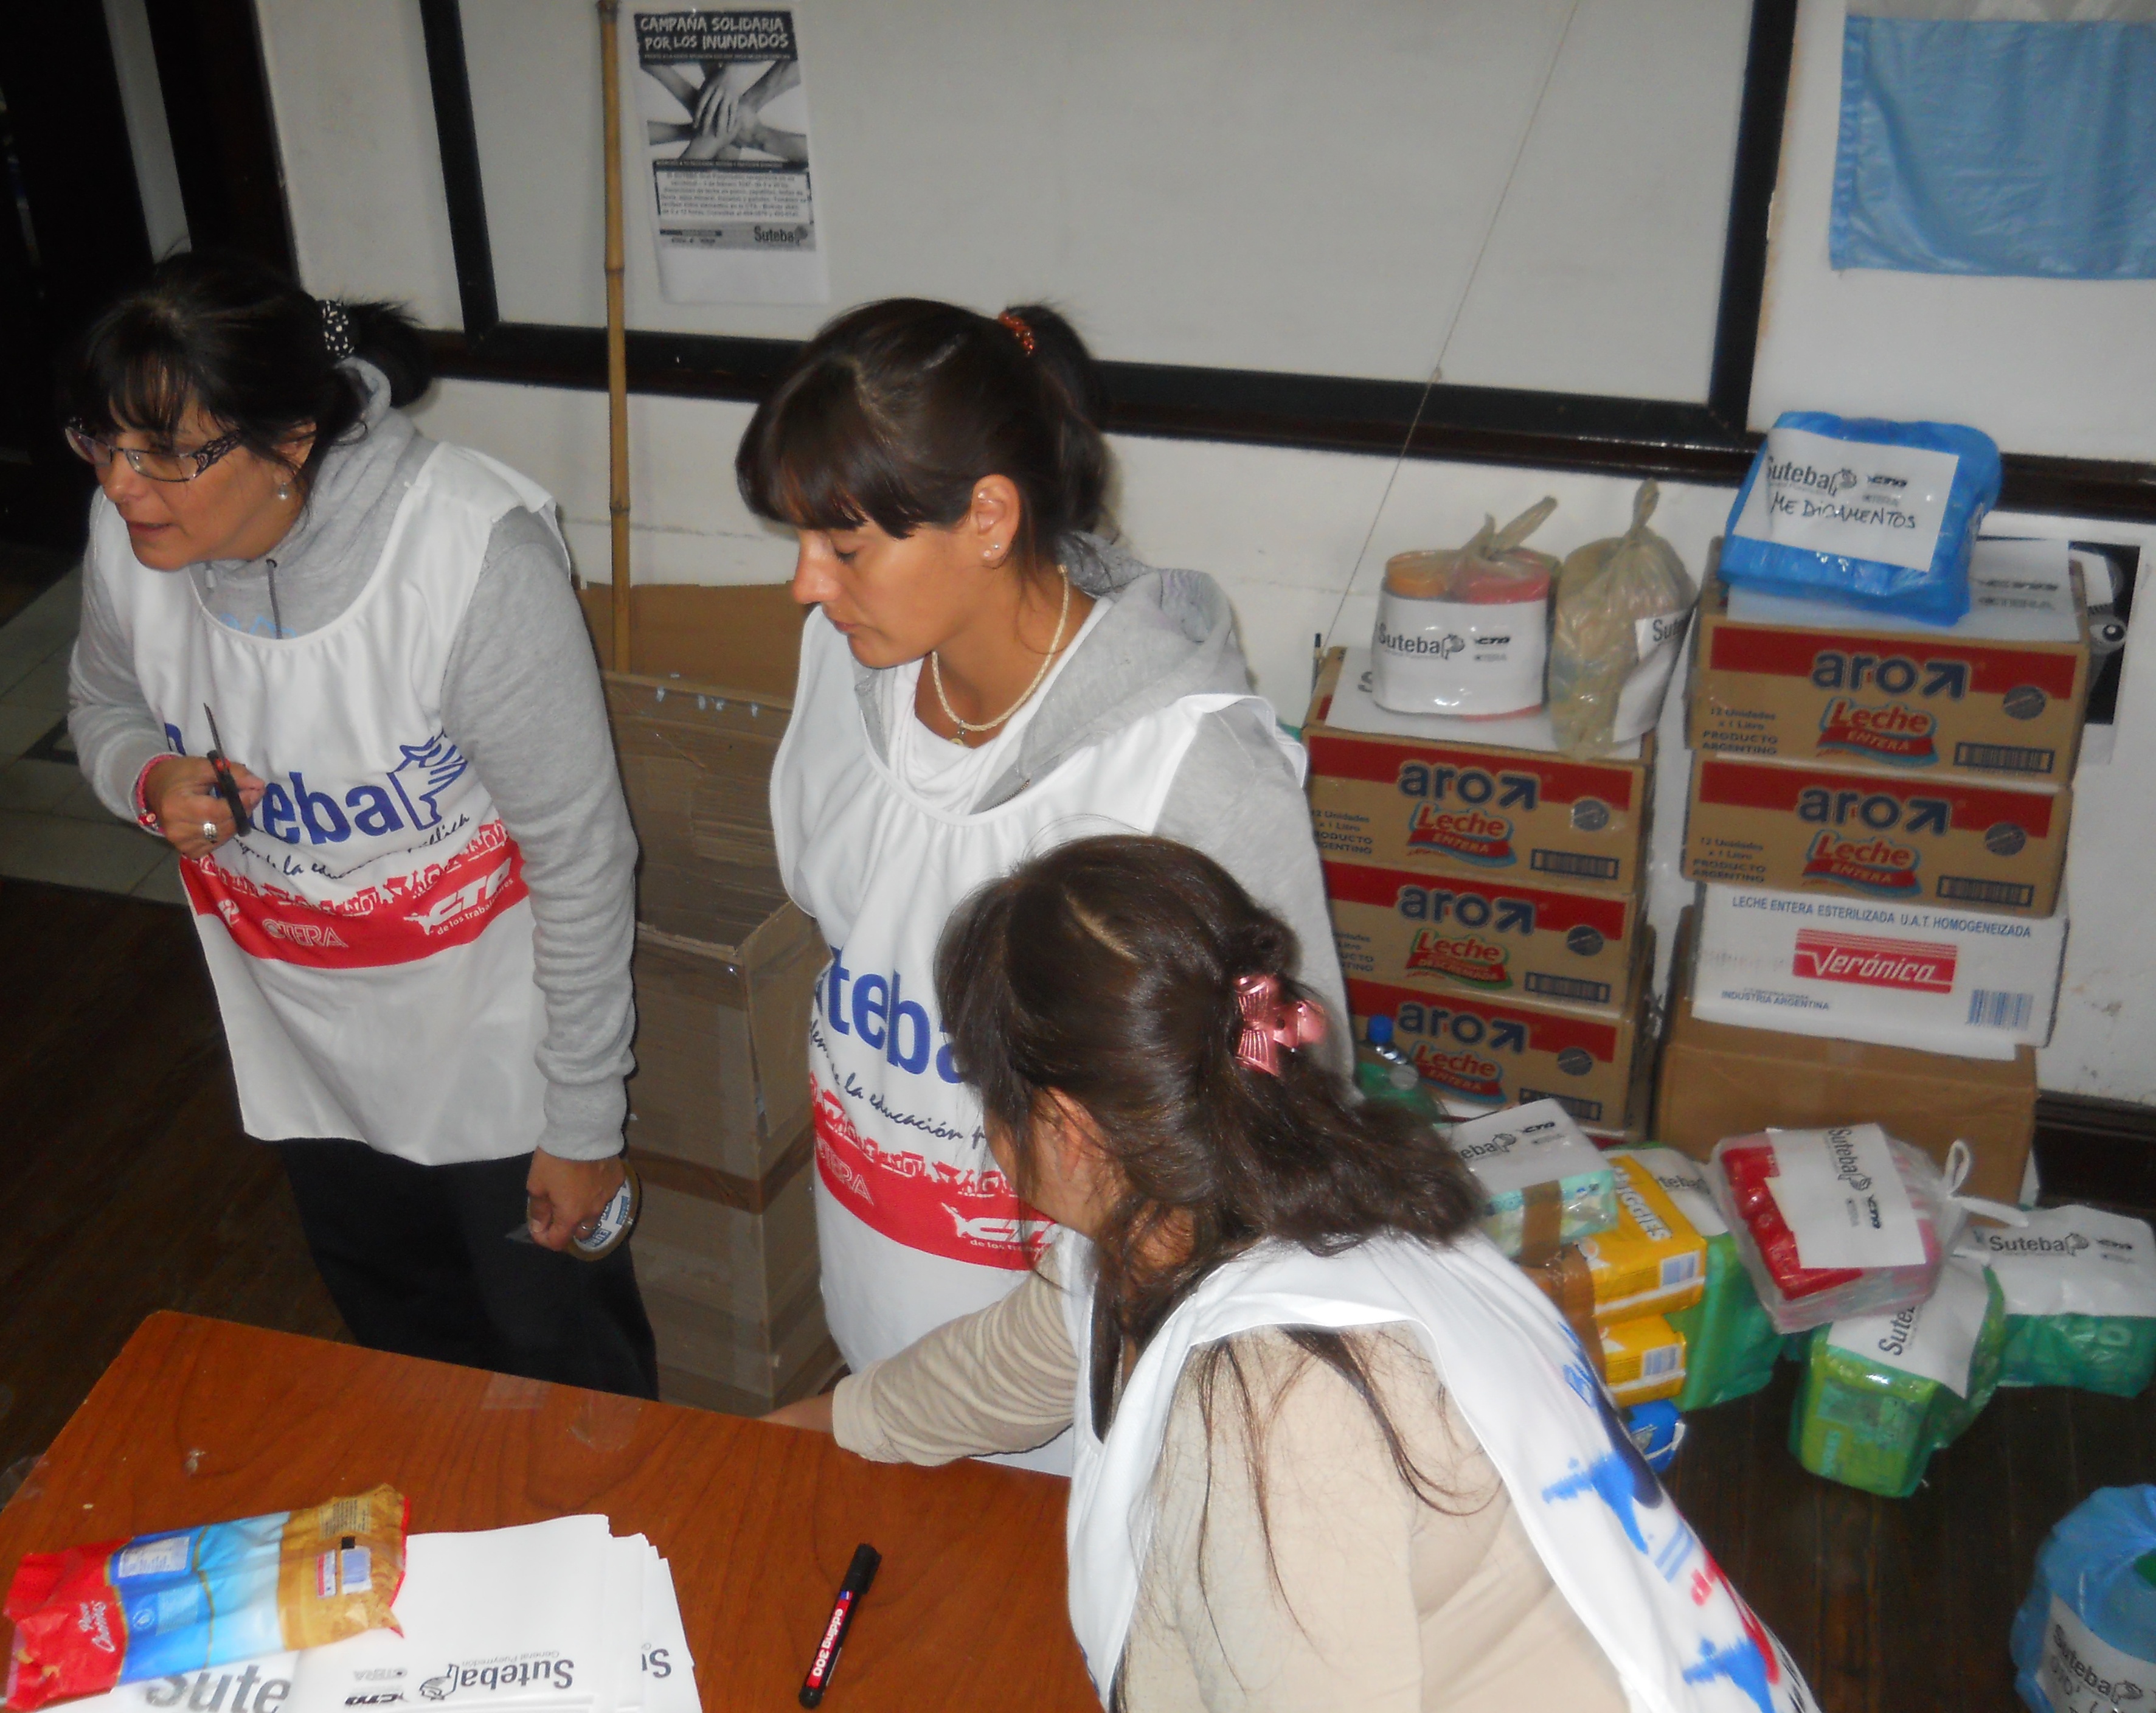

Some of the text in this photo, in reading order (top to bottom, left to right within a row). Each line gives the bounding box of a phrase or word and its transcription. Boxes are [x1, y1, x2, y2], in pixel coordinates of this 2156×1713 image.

[640, 15, 783, 32] CAMPAÑA SOLIDARIA
[645, 33, 789, 50] POR LOS INUNDADOS
[1831, 701, 1929, 734] Leche
[1703, 730, 1778, 744] PRODUCTO
[1703, 742, 1777, 755] ARGENTINO
[1418, 807, 1504, 837] Leche
[1816, 835, 1910, 866] Leche
[437, 925, 449, 935] de
[449, 916, 463, 927] los
[1732, 896, 1767, 910] LECHE
[1770, 899, 1814, 915] ENTERA
[1817, 904, 1895, 923] ESTERILIZADA
[1932, 916, 2031, 939] HOMOGENEIZADA
[1416, 932, 1500, 961] Leche
[1415, 1044, 1496, 1077] Leche
[1828, 1127, 1858, 1173] Suteba
[1989, 1235, 2065, 1252] Suteba
[1878, 1307, 1915, 1356] Sute
[822, 1608, 843, 1649] edding
[460, 1658, 575, 1689] Suteba
